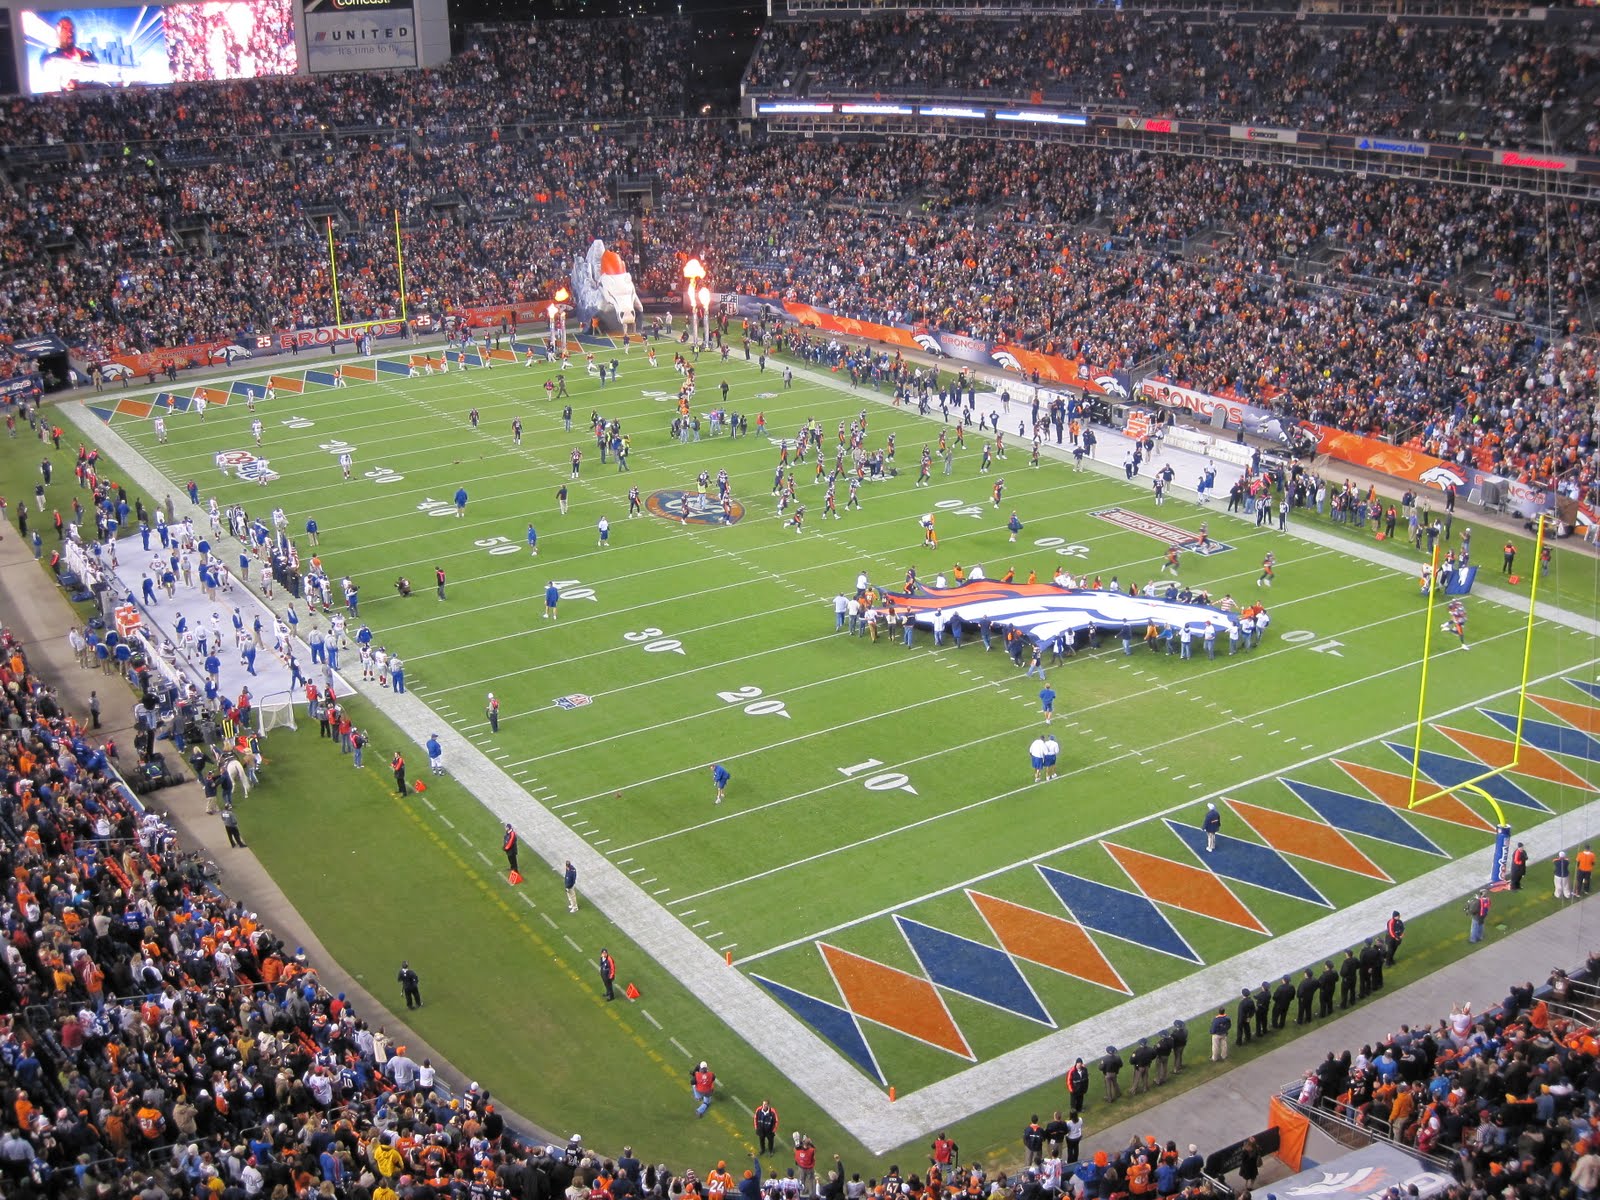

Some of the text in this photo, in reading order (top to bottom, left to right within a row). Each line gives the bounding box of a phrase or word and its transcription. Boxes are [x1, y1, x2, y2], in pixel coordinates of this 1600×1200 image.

[332, 27, 408, 41] UNITED
[338, 44, 400, 58] It's time to fly
[1373, 140, 1425, 154] Invesco Aim
[1502, 152, 1566, 170] Budweiser
[417, 315, 431, 326] 25
[256, 336, 271, 348] 25
[280, 321, 401, 350] BRONCOS
[941, 335, 986, 352] BRONCOS
[281, 417, 315, 429] 10
[319, 441, 358, 454] 20
[364, 468, 405, 484] 30
[1474, 474, 1546, 505] BNCOS
[416, 500, 459, 517] 40
[934, 500, 984, 517] 40
[474, 535, 522, 556] 50
[1033, 536, 1090, 555] 30
[623, 627, 683, 653] 30
[1280, 630, 1345, 653] 10
[716, 686, 786, 716] 20
[837, 758, 910, 792] 10
[343, 1078, 353, 1088] 10
[709, 1180, 726, 1194] 24
[886, 1182, 900, 1194] 47
